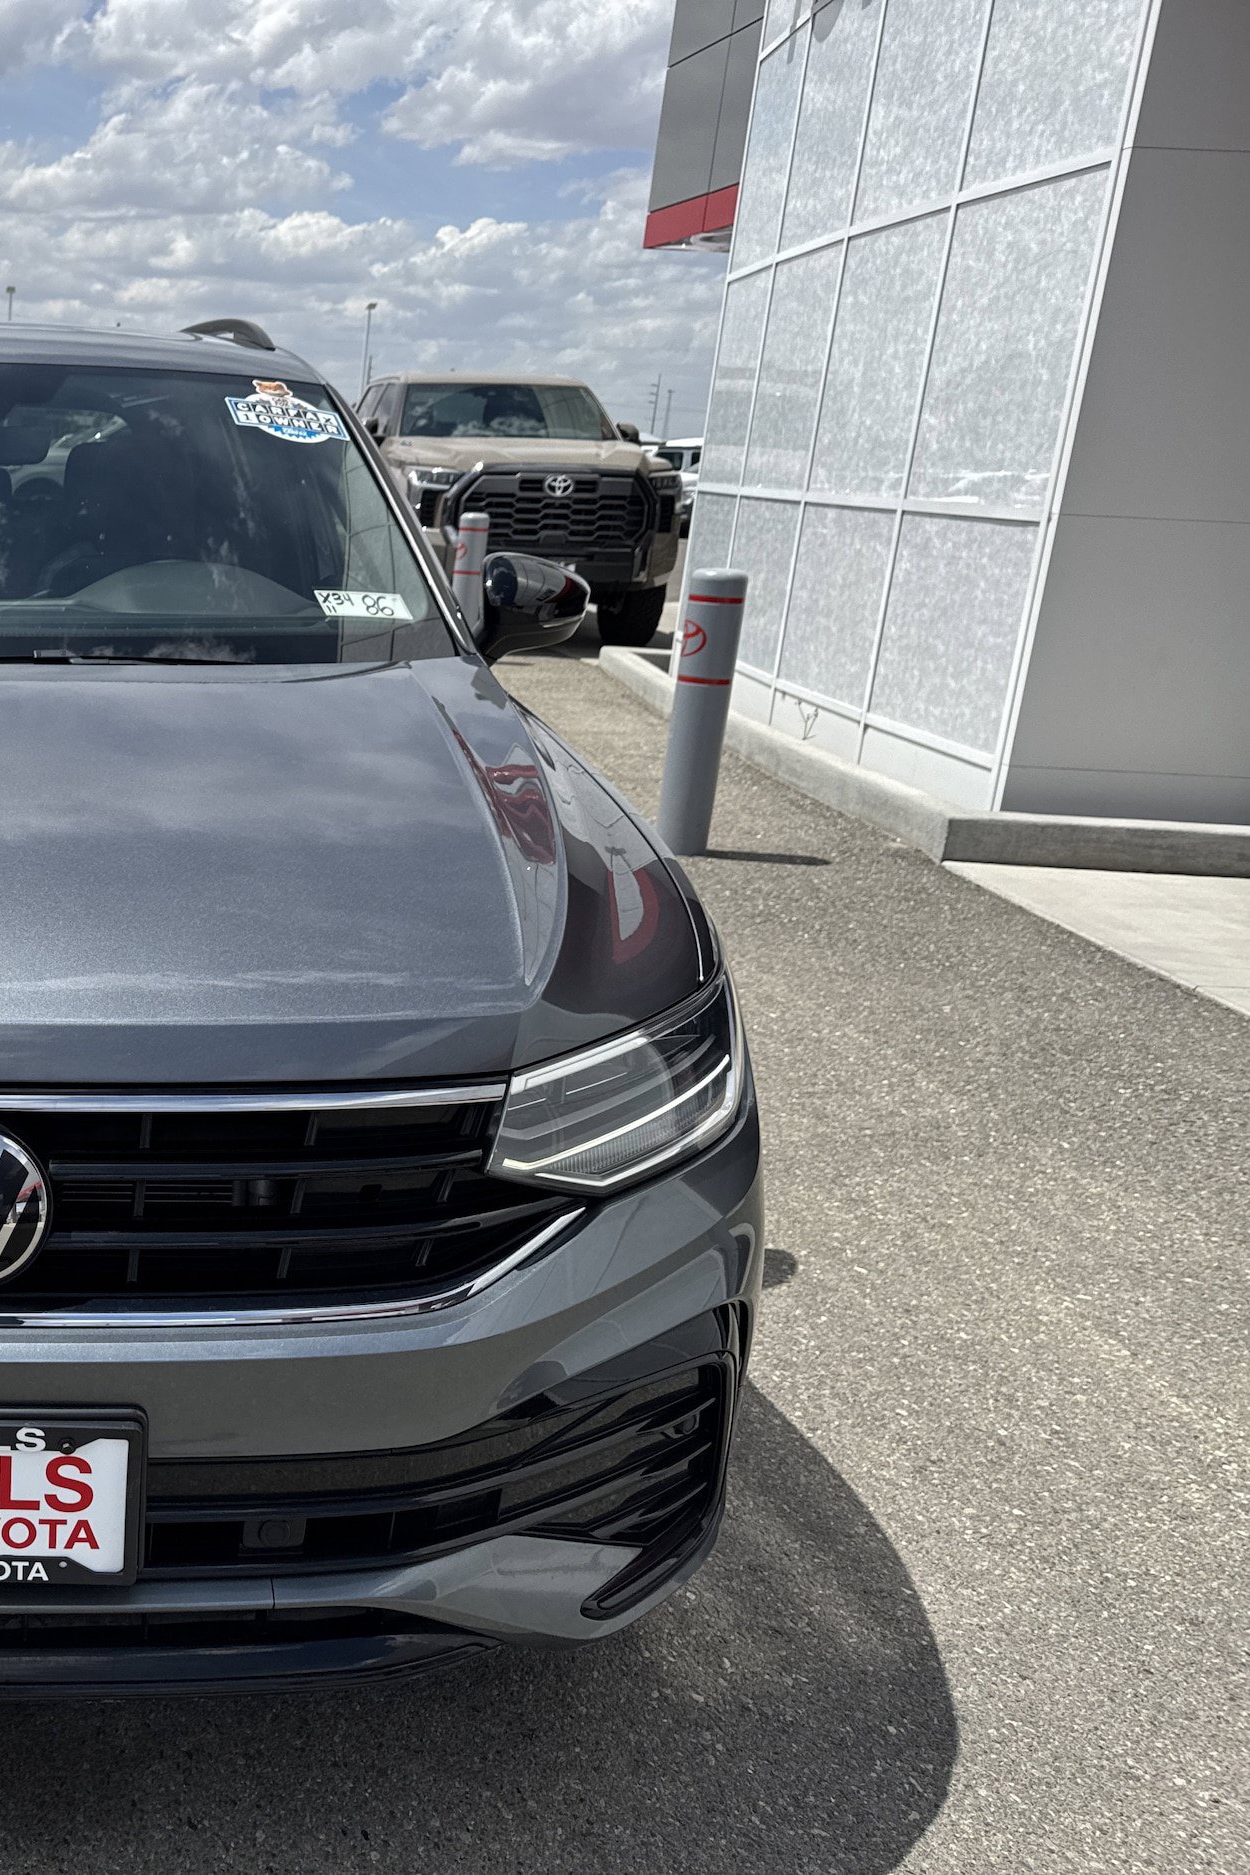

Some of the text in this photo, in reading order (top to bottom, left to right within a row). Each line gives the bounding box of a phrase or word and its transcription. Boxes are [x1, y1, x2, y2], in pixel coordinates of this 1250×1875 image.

[236, 402, 337, 426] CARFAX
[258, 414, 339, 435] OWNER
[362, 594, 395, 617] 86
